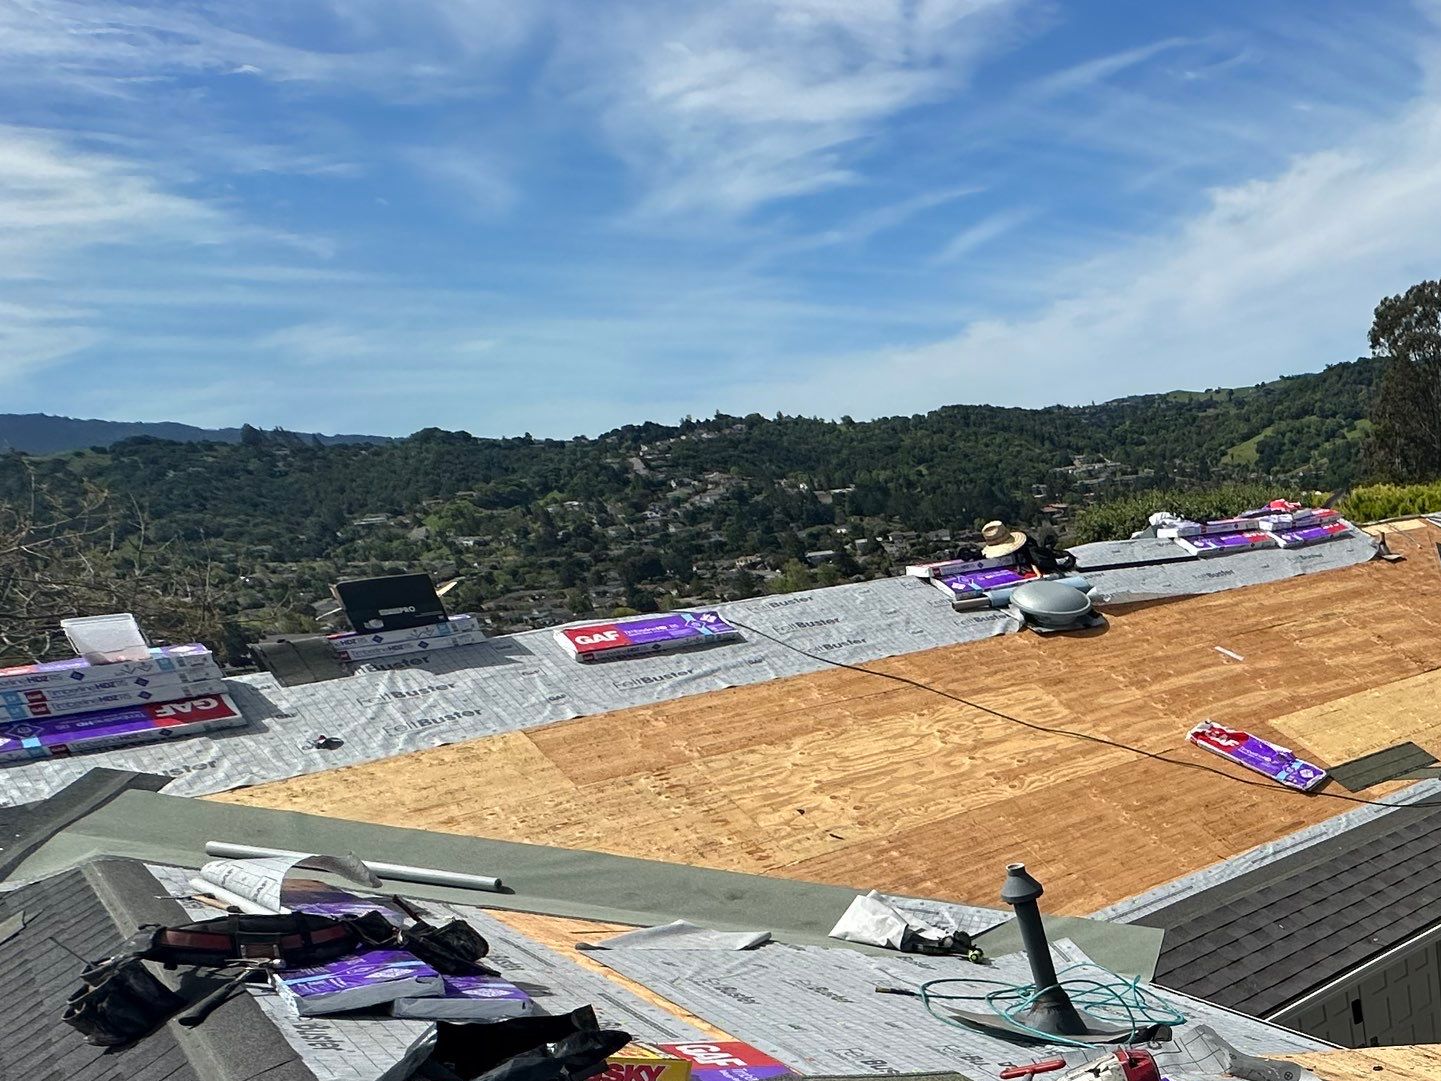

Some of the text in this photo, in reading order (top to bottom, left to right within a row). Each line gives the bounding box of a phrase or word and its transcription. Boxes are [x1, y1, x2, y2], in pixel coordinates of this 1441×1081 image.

[575, 630, 620, 645] GAF
[613, 667, 696, 688] FeltBuster
[155, 699, 220, 717] GAF
[383, 708, 482, 735] FeltBuster
[676, 1044, 747, 1066] GAF
